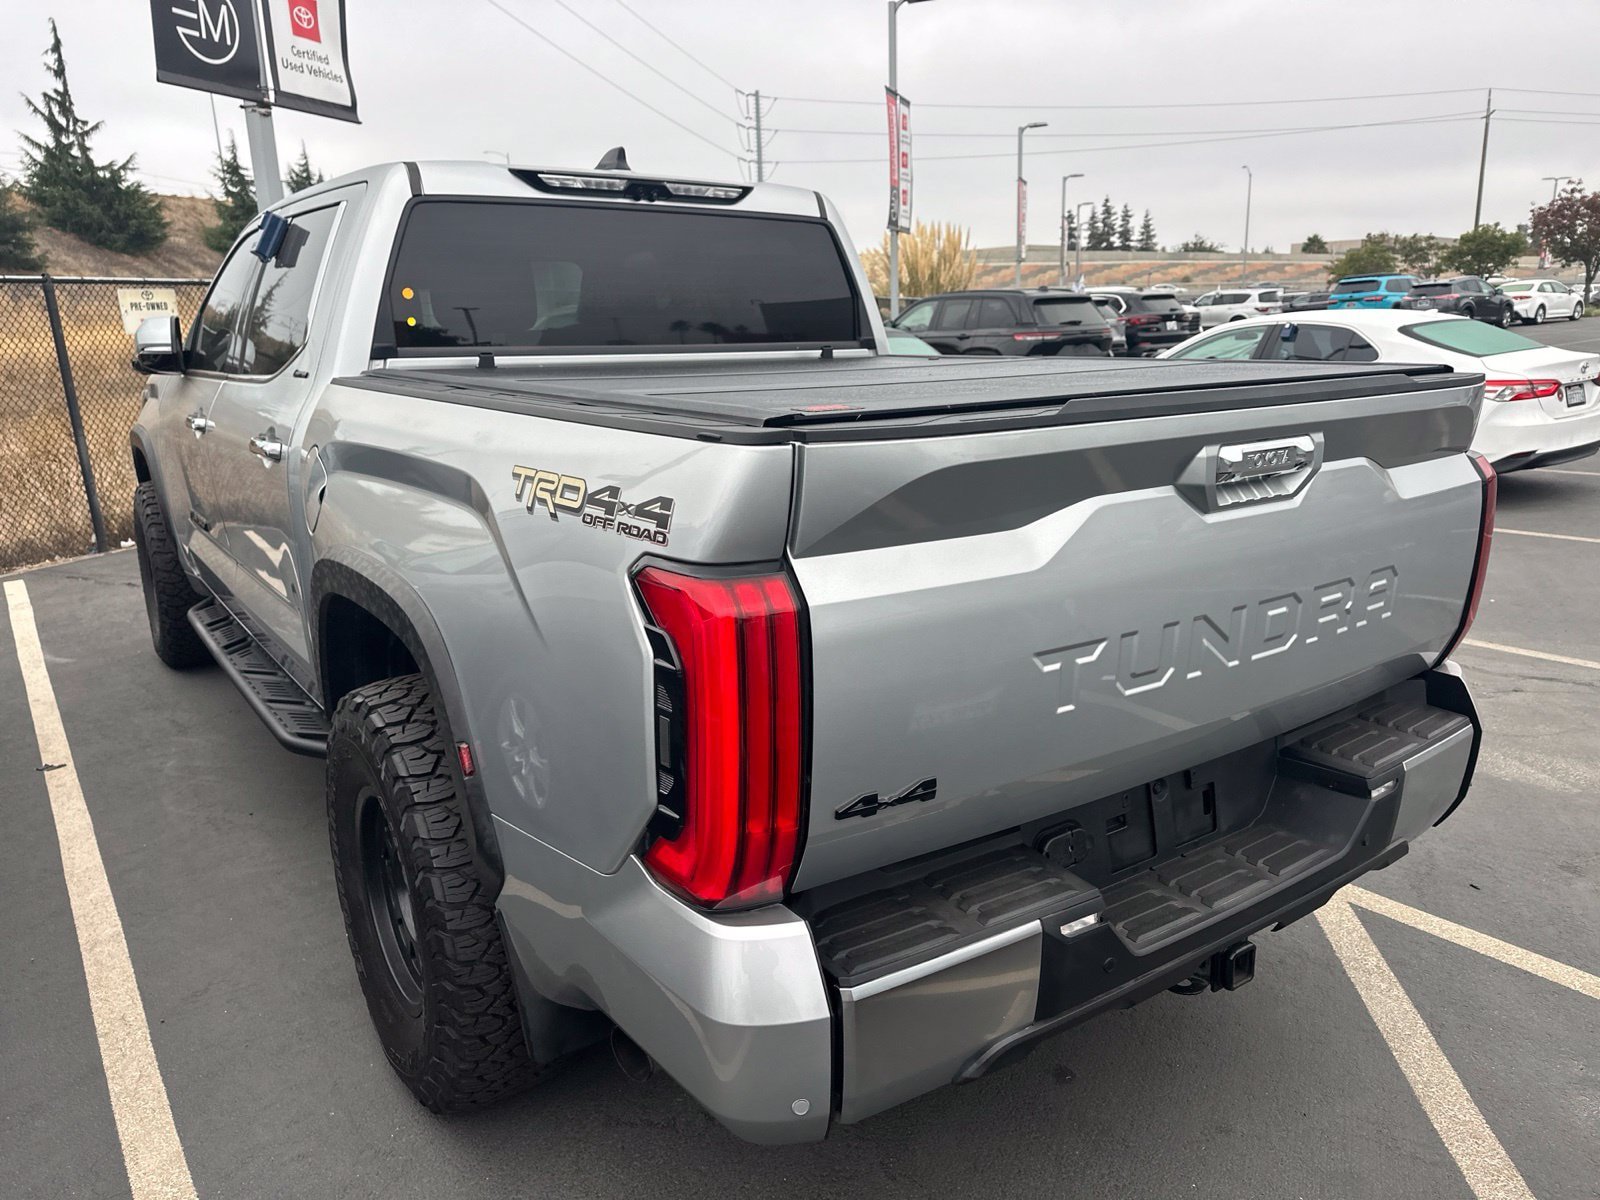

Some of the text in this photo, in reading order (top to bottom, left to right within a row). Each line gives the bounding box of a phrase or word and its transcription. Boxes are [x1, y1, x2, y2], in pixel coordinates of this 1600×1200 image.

[281, 57, 344, 83] Used Vehicles
[291, 45, 330, 65] Certified
[129, 301, 169, 312] PRE-OWNED
[512, 464, 588, 521] TRD
[581, 513, 669, 548] OFF ROAD
[1032, 564, 1399, 714] TUNDRA
